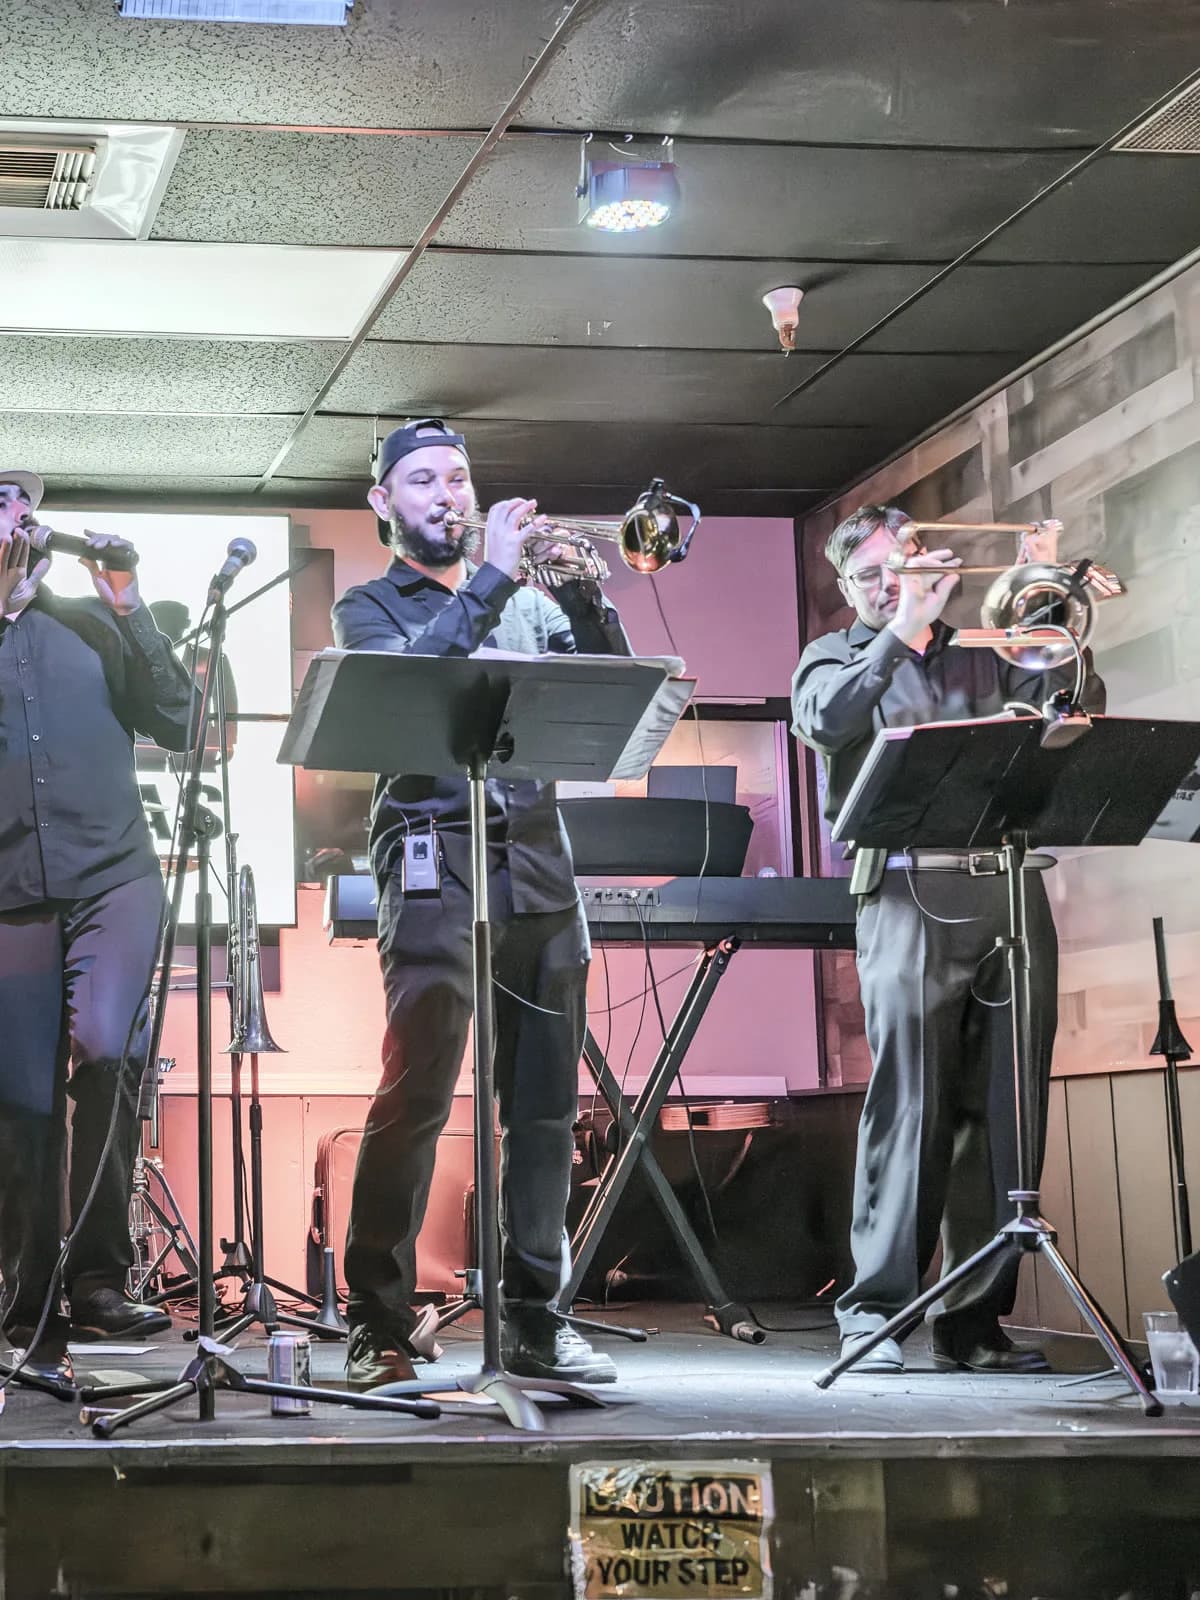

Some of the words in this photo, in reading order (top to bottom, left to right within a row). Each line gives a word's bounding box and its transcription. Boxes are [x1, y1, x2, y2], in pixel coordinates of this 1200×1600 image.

[621, 1523, 721, 1550] WATCH
[597, 1558, 671, 1585] YOUR
[678, 1557, 750, 1586] STEP
